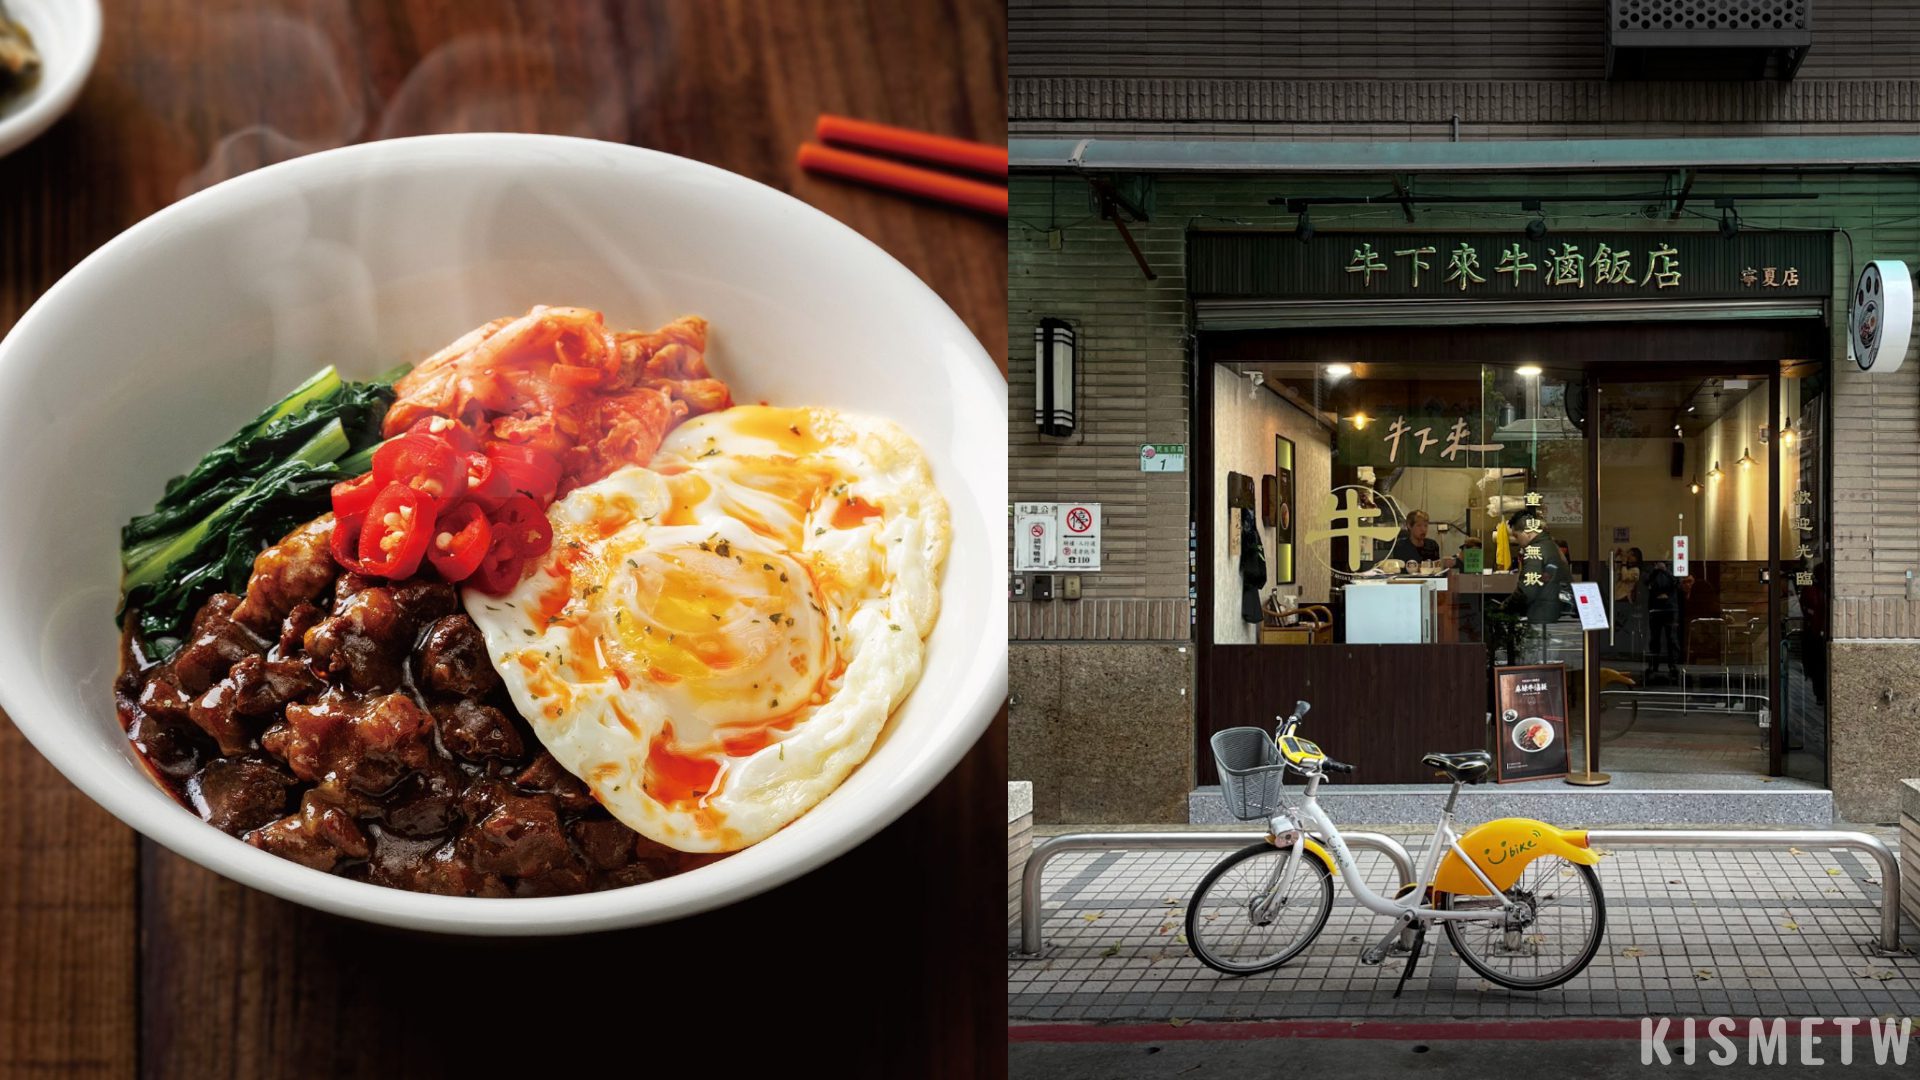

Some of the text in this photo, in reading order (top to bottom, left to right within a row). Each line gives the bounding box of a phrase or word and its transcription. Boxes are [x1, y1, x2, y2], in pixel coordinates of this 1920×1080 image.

[1344, 242, 1682, 291] 牛下來牛滷飯店
[1740, 267, 1799, 287] 寧夏店
[1160, 458, 1167, 471] 1
[1304, 488, 1401, 572] 牛
[1523, 492, 1544, 587] 童叟無欺
[1077, 556, 1090, 564] 110
